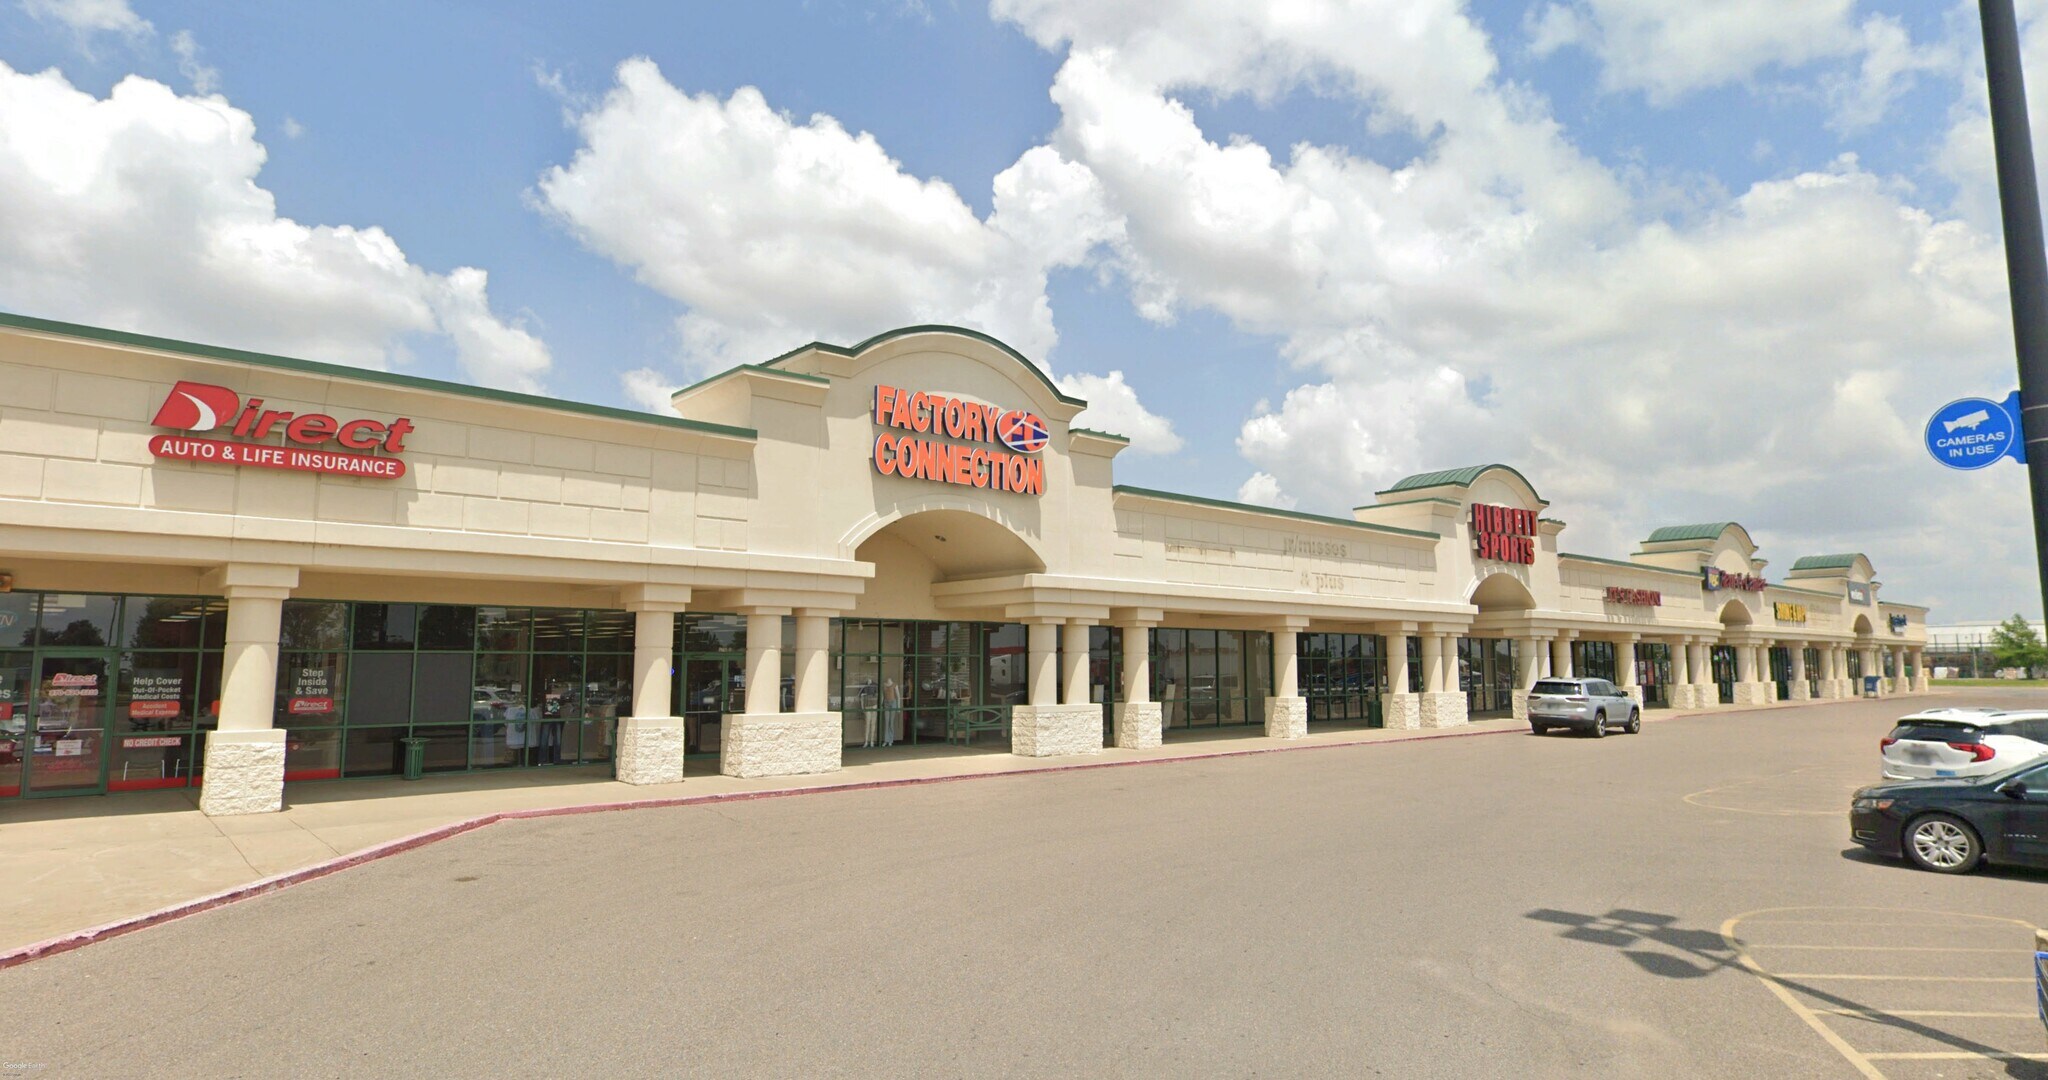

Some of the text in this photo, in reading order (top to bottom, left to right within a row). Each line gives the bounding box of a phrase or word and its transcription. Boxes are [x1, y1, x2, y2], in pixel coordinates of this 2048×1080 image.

[150, 380, 415, 453] Direct
[874, 384, 999, 443] FACTORY
[1936, 431, 2006, 448] CAMERAS
[160, 439, 397, 476] AUTO & LIFE INSURANCE
[1949, 444, 1995, 458] IN USE
[873, 432, 1043, 496] CONNECTION
[1471, 503, 1537, 537] HIBBETT
[1476, 530, 1535, 565] SPORTS
[133, 677, 182, 686] Help Cover
[302, 668, 324, 678] Step
[295, 686, 329, 695] & Save
[297, 678, 327, 686] Inside
[123, 737, 182, 748] NO CREDIT CHECK
